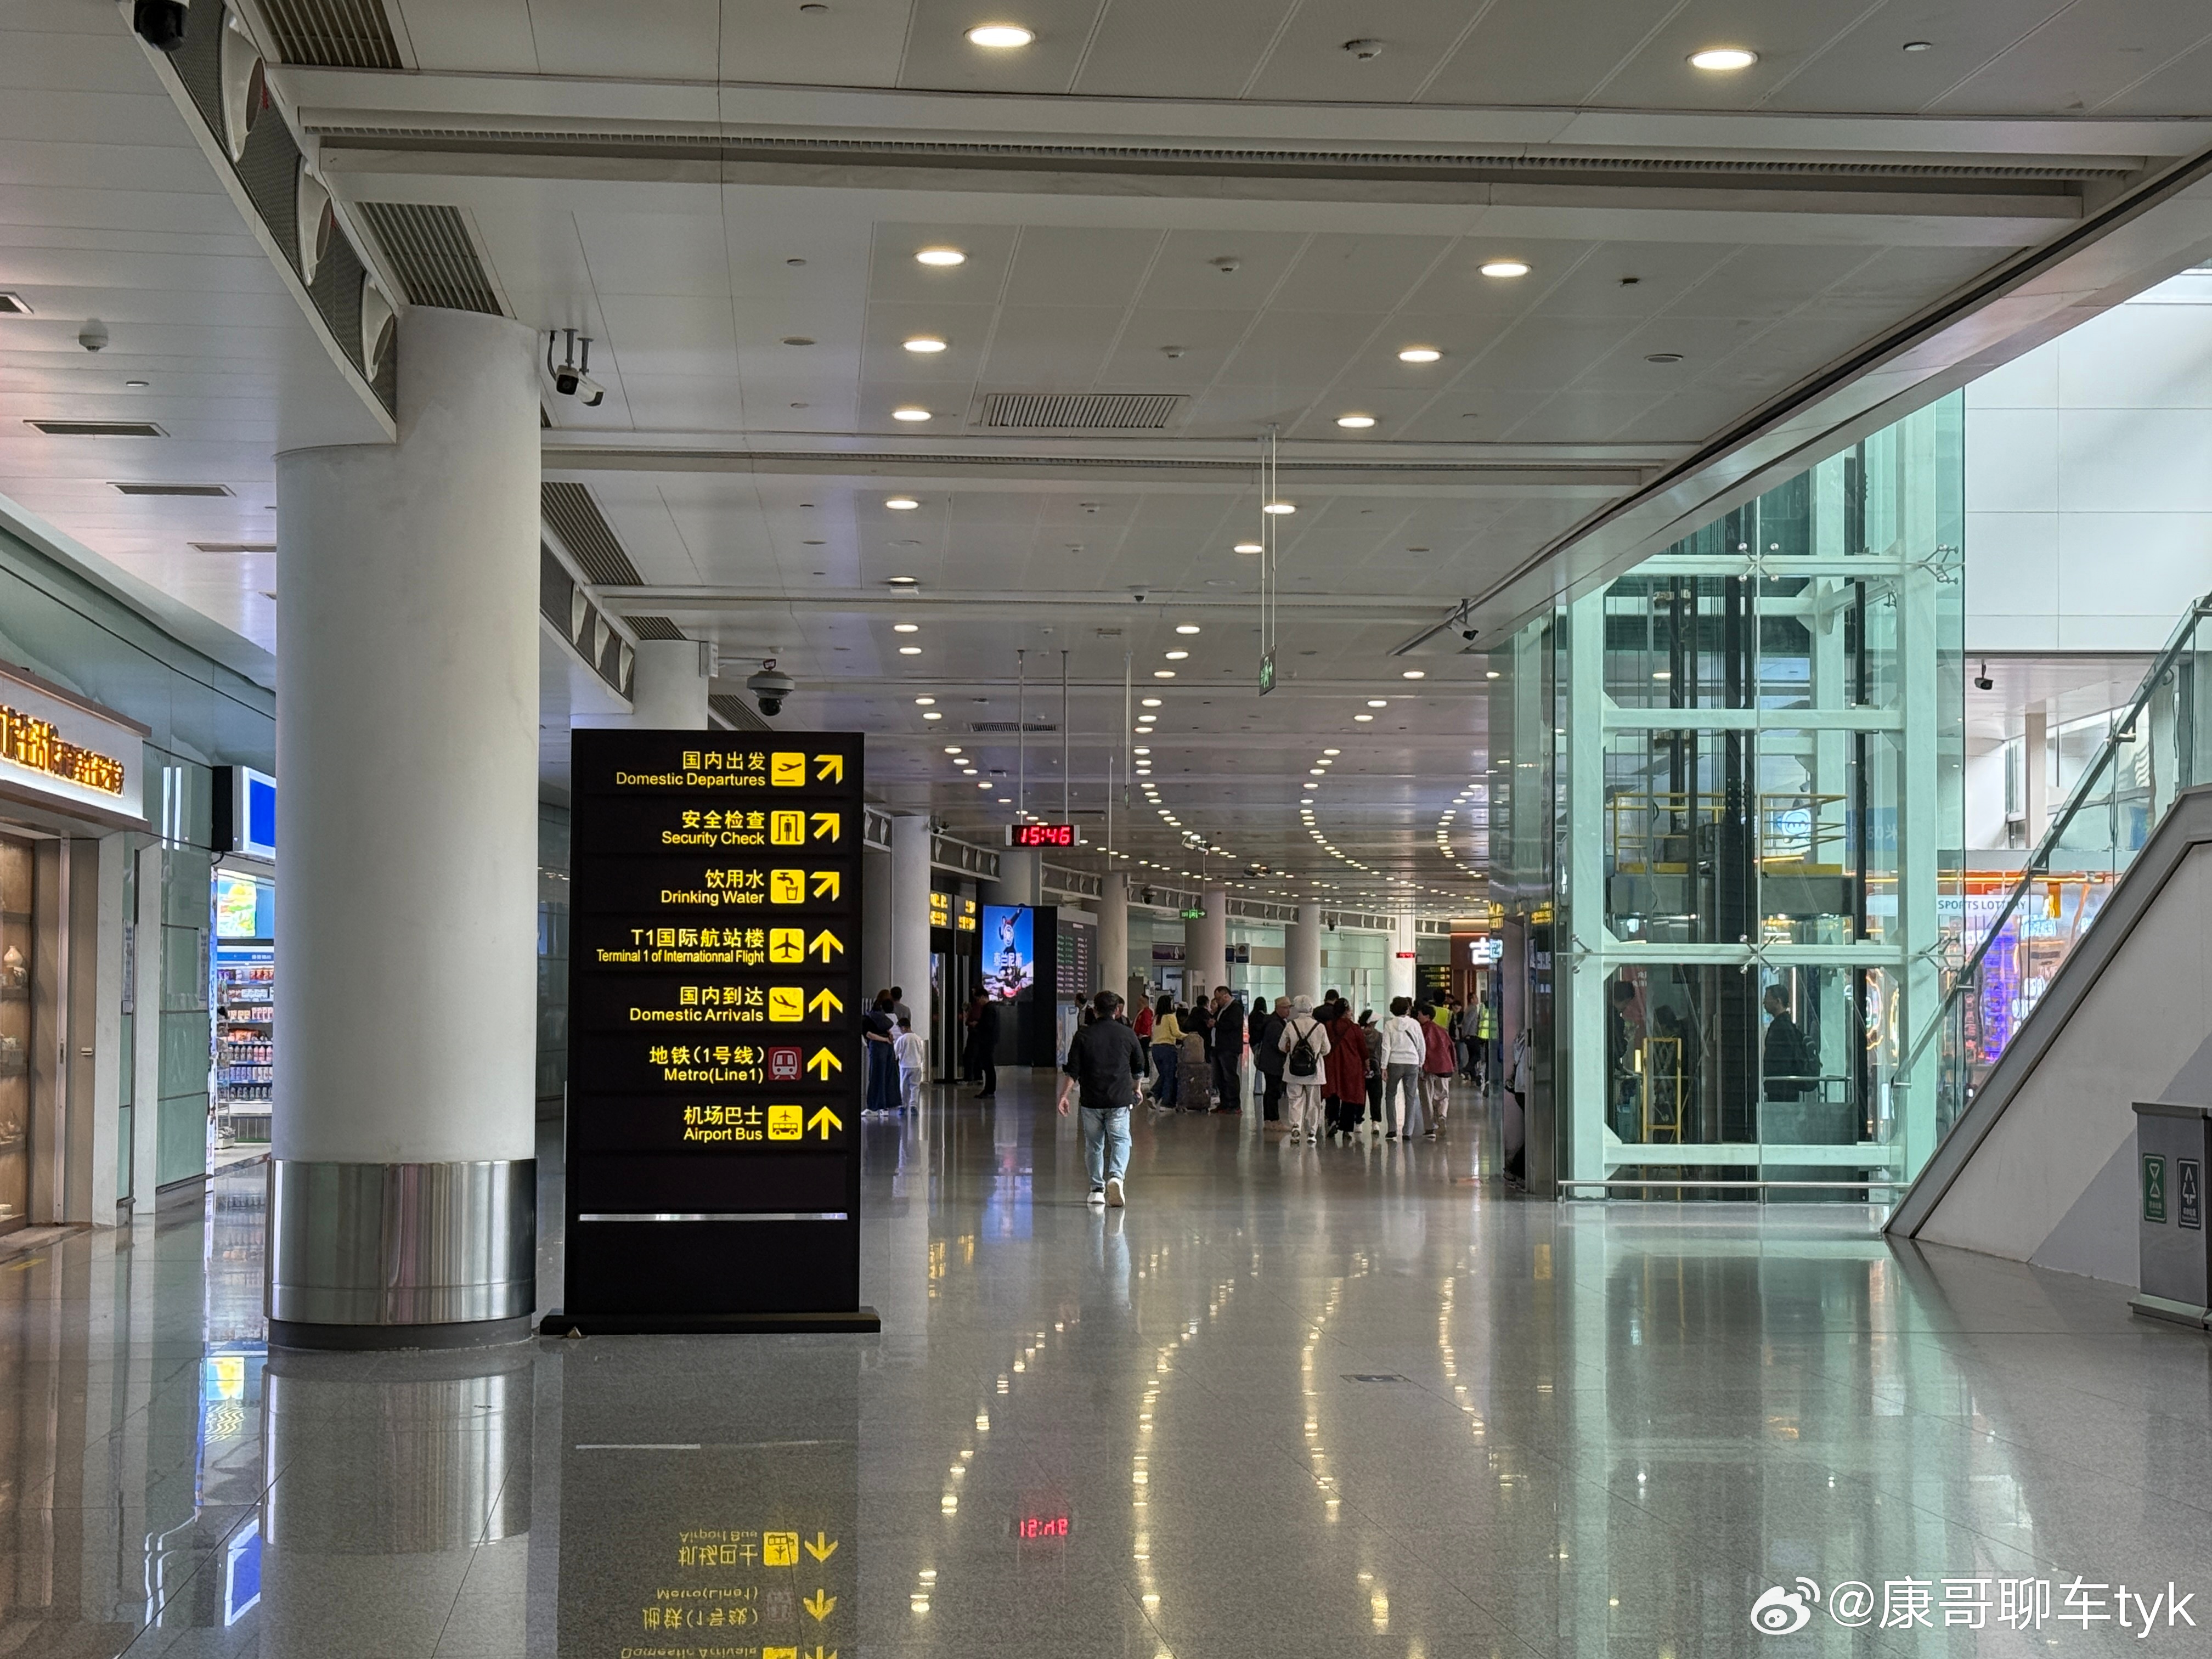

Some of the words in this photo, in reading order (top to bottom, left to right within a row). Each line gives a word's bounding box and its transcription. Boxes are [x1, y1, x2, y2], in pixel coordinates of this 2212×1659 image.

[682, 751, 765, 771] 国内出发
[616, 772, 684, 786] Domestic
[686, 772, 766, 788] Departures
[682, 809, 765, 830] 安全检查
[662, 831, 718, 848] Security
[721, 831, 765, 845] Check
[1020, 825, 1071, 846] 15:46
[704, 868, 765, 889] 饮用水
[661, 890, 719, 907] Drinking
[723, 890, 765, 904] Water
[630, 928, 765, 948] T1国际航站楼
[596, 949, 641, 962] Terminal
[643, 949, 648, 962] 1
[651, 949, 663, 962] of
[735, 949, 765, 966] Flight
[680, 986, 764, 1006] 国内到达
[630, 1008, 702, 1022] Domestic
[704, 1008, 764, 1022] Arrivals
[649, 1045, 764, 1065] 地铁(1号线)
[664, 1068, 764, 1084] Metro(Line1)
[684, 1105, 763, 1125] 机场巴士
[683, 1127, 732, 1143] Airport
[735, 1127, 763, 1141] Bus
